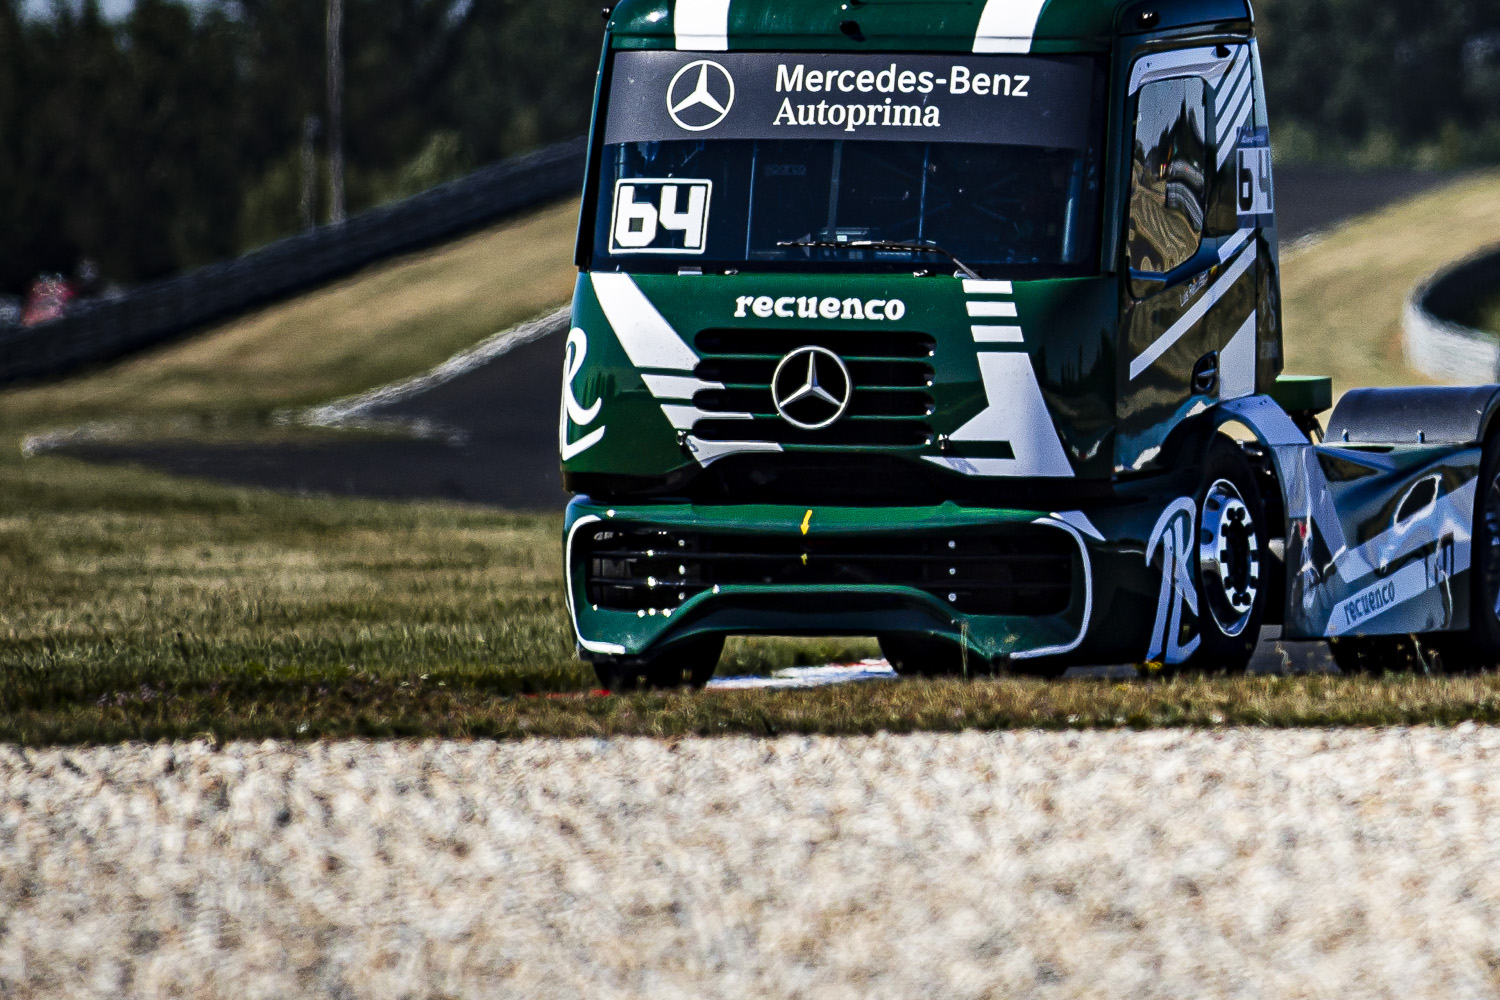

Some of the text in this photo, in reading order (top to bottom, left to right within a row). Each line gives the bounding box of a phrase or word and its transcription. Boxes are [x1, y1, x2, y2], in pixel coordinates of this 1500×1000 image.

[775, 63, 1030, 97] Mercedes-Benz
[772, 97, 941, 132] Autoprima
[614, 185, 706, 248] 64
[733, 295, 906, 321] recuenco
[1344, 579, 1396, 626] recuenco
